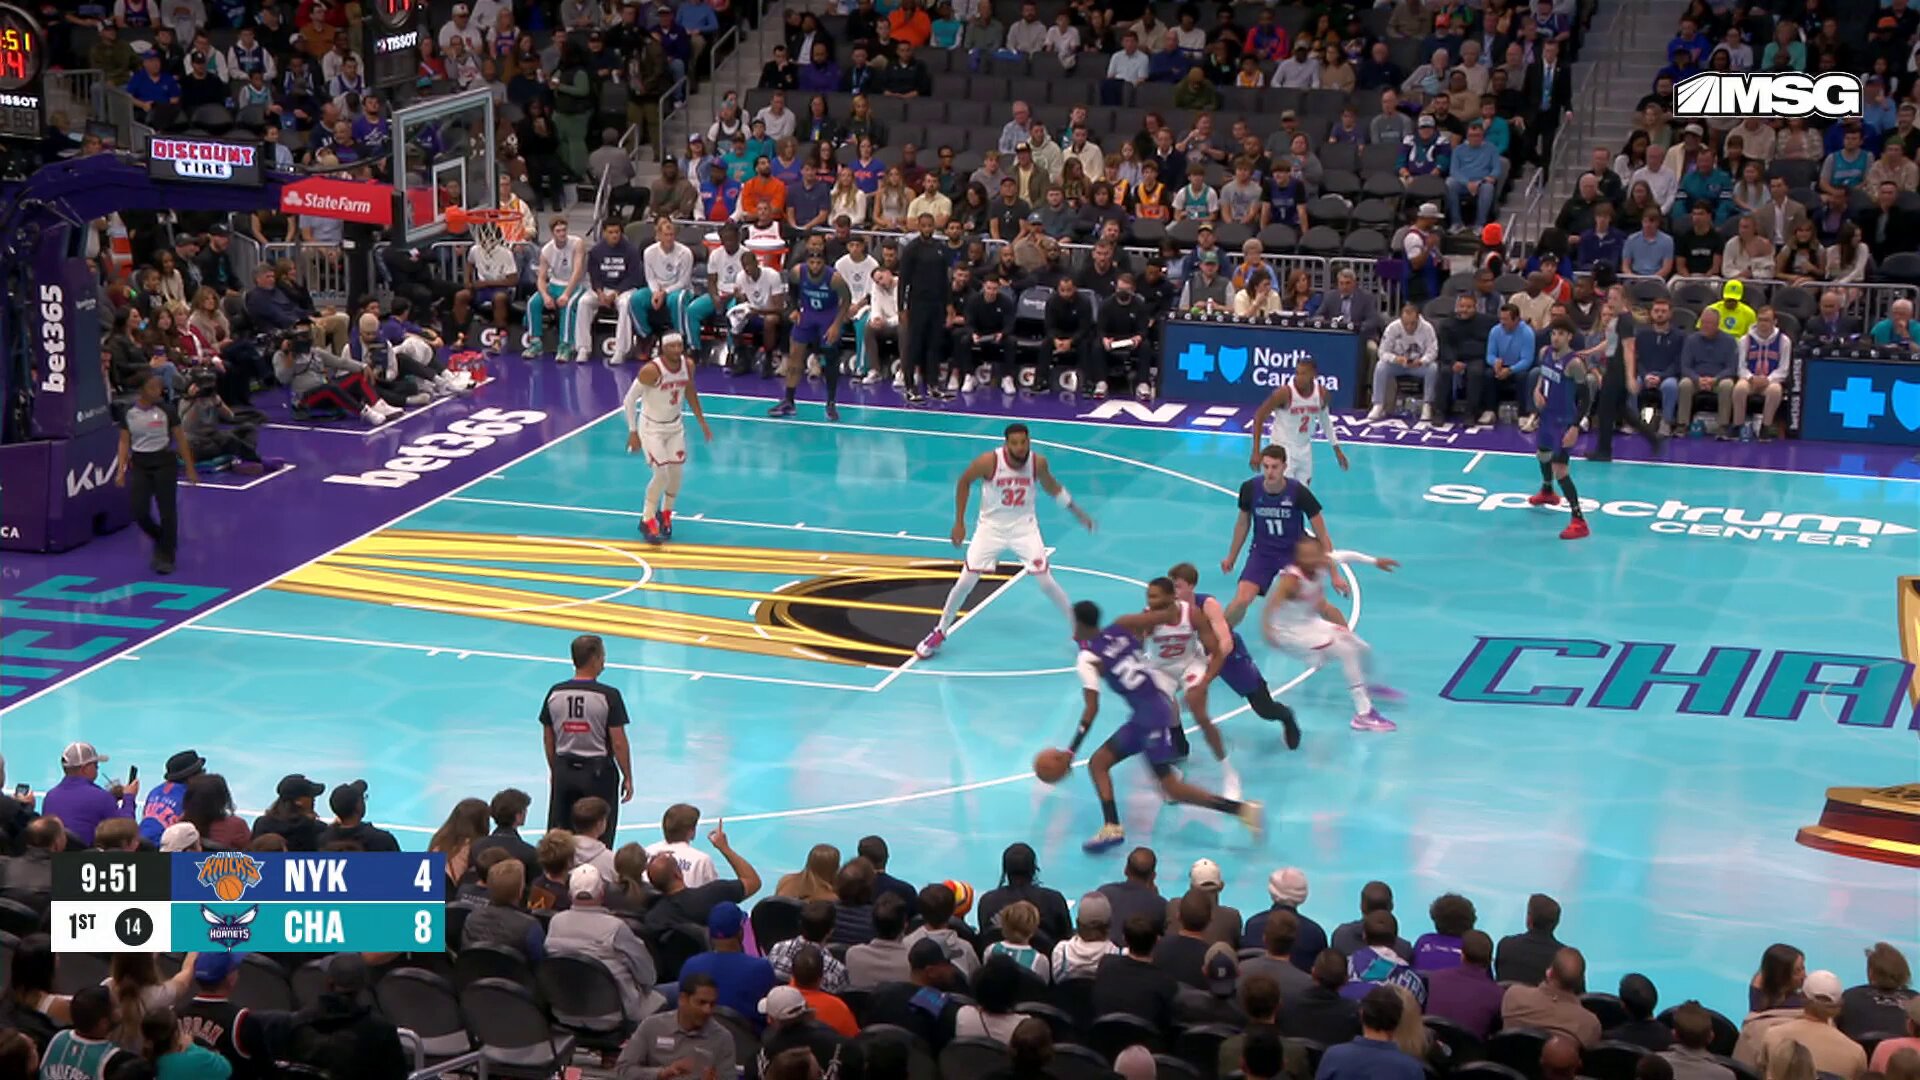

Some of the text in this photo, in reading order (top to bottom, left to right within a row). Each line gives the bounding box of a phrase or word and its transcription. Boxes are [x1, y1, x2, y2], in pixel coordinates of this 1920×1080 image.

[386, 31, 417, 52] TISSOT
[0, 94, 39, 108] ISSOT
[151, 138, 255, 166] DISCOUNT
[182, 162, 225, 176] TIRE
[40, 285, 66, 393] bet365
[1252, 367, 1339, 391] Carna
[1298, 415, 1311, 433] 2
[322, 407, 548, 489] bet365
[1001, 488, 1026, 507] 32
[1265, 519, 1284, 537] 11
[1650, 521, 1874, 548] CENTER
[0, 574, 231, 697] ETS
[1439, 635, 1920, 732] CHA
[566, 695, 585, 719] 16
